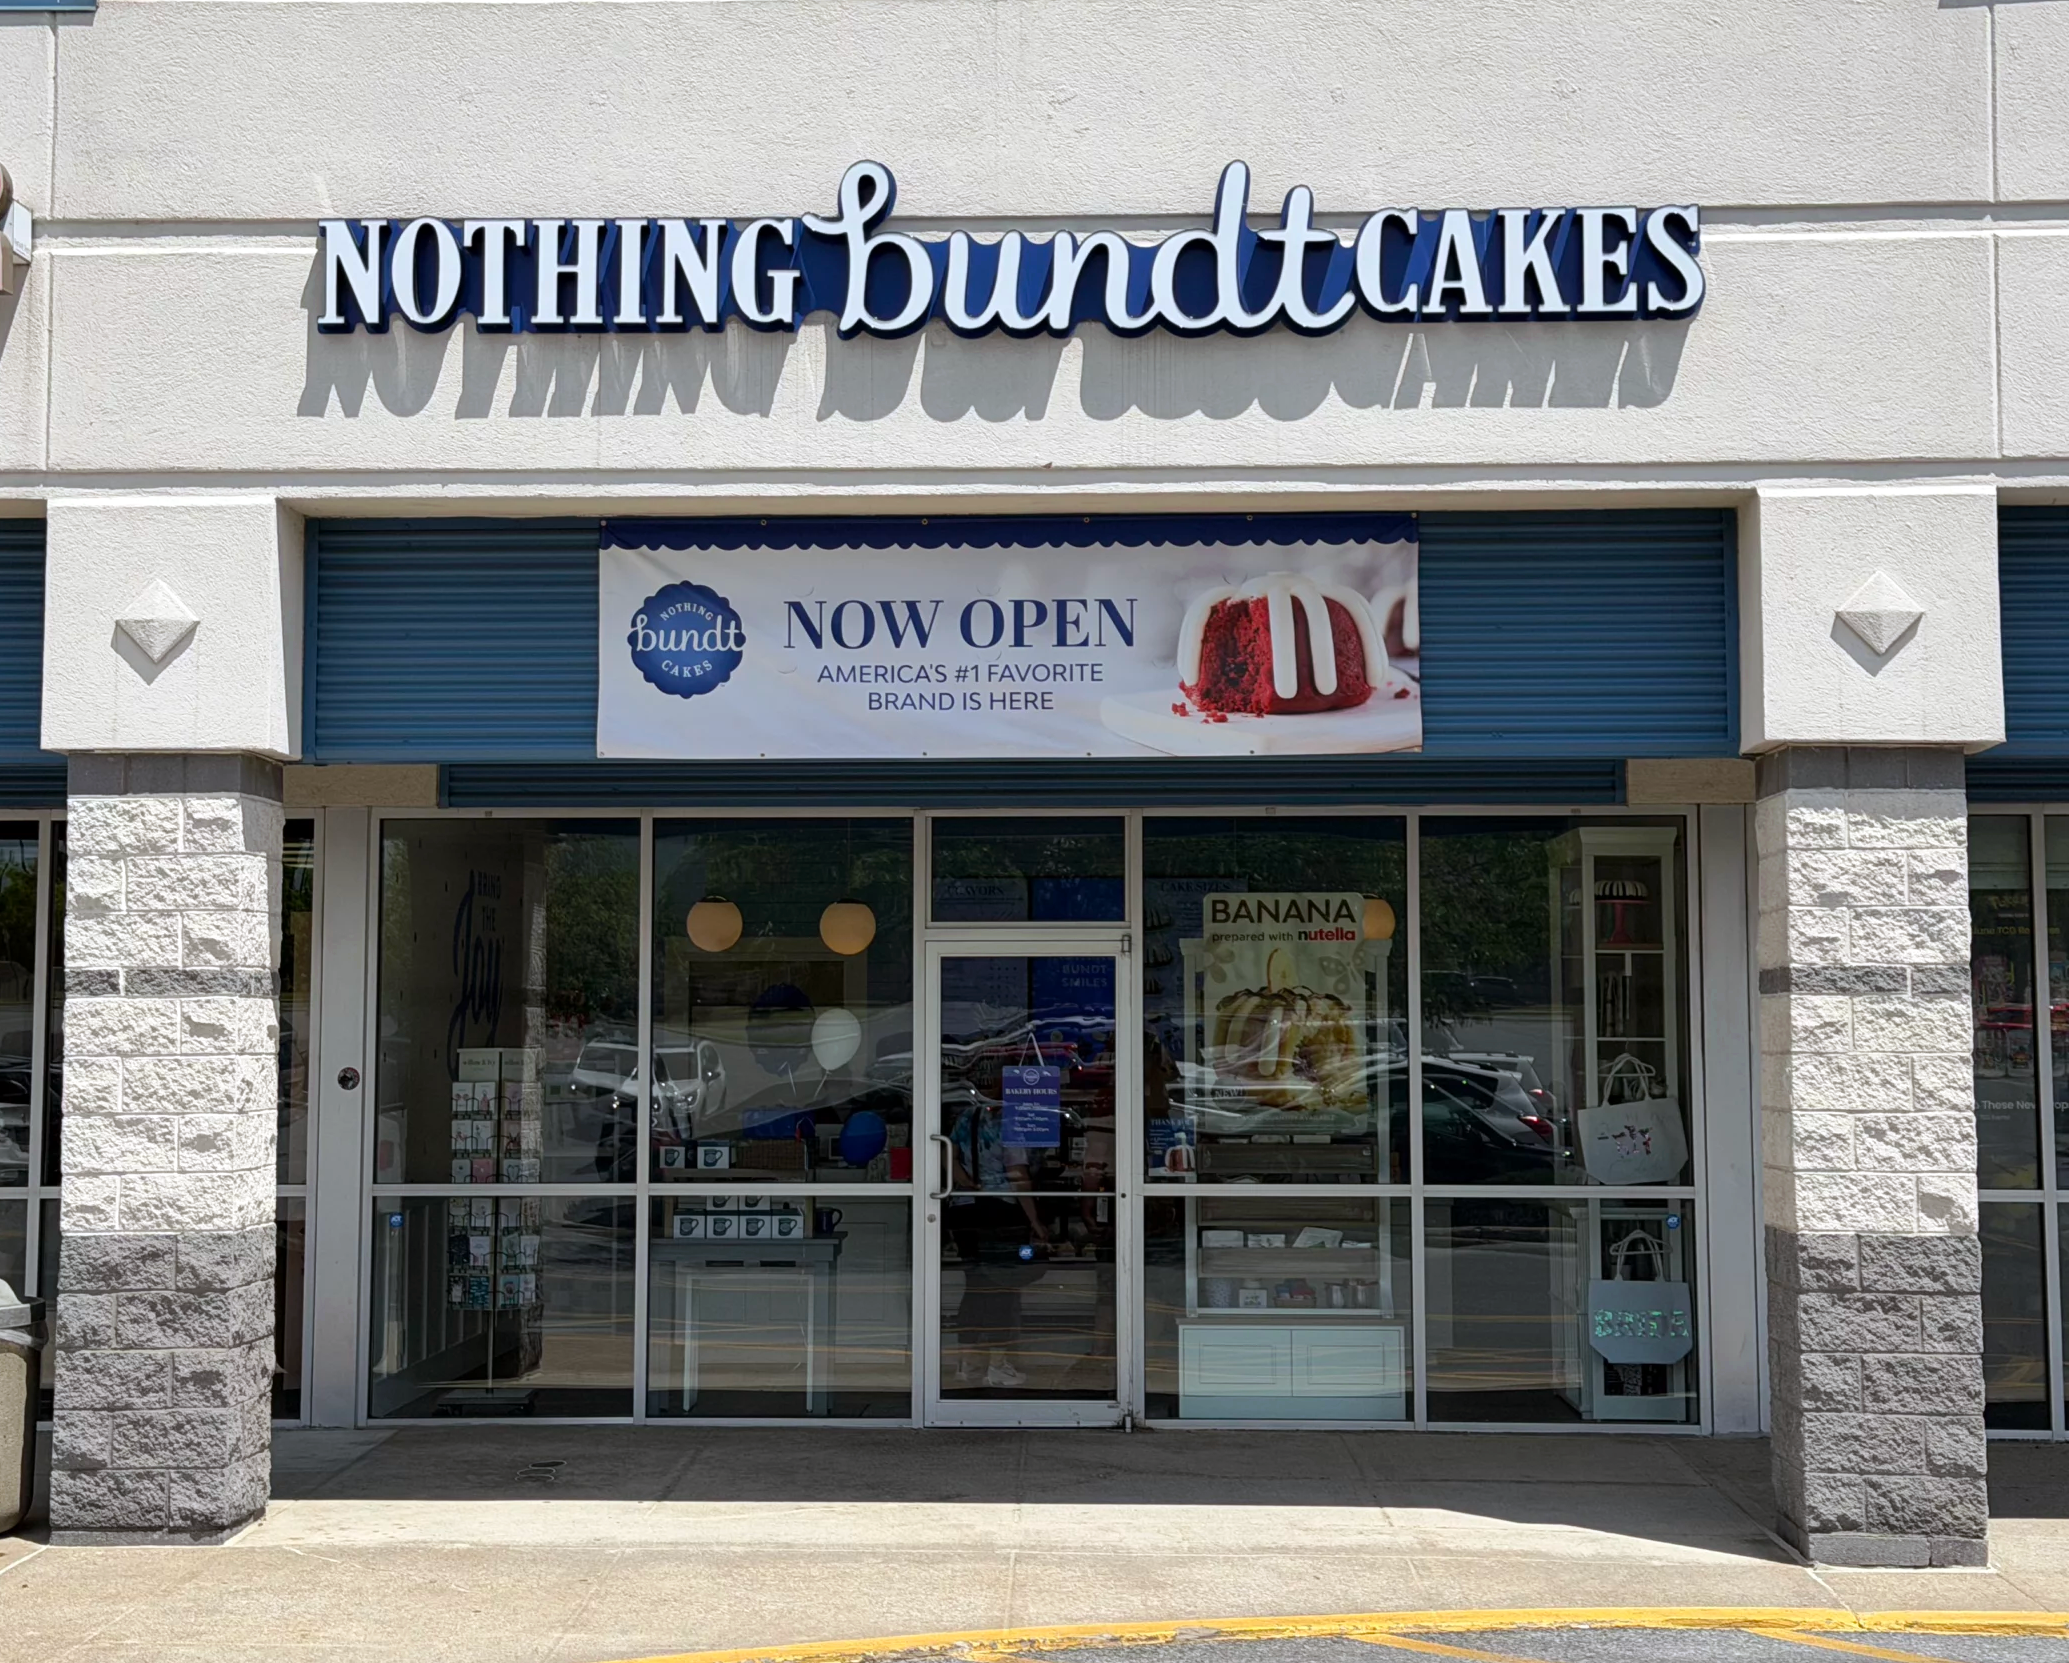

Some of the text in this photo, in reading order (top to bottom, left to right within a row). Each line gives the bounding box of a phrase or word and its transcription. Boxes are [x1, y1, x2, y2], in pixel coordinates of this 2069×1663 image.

[317, 159, 1704, 336] NOTHING bundt CAKES
[660, 602, 714, 621] NOTHING
[632, 614, 743, 651] bundt
[783, 598, 1138, 649] NOW OPEN
[661, 660, 713, 678] CAKES
[817, 663, 1104, 683] AMERICA'S #1 FAVORITE
[868, 691, 1054, 711] BRAND IS HERE
[1211, 899, 1357, 924] BANANA
[1212, 926, 1356, 943] prepared with nutella
[1062, 964, 1107, 975] BUNDT
[1062, 977, 1107, 988] SMILES
